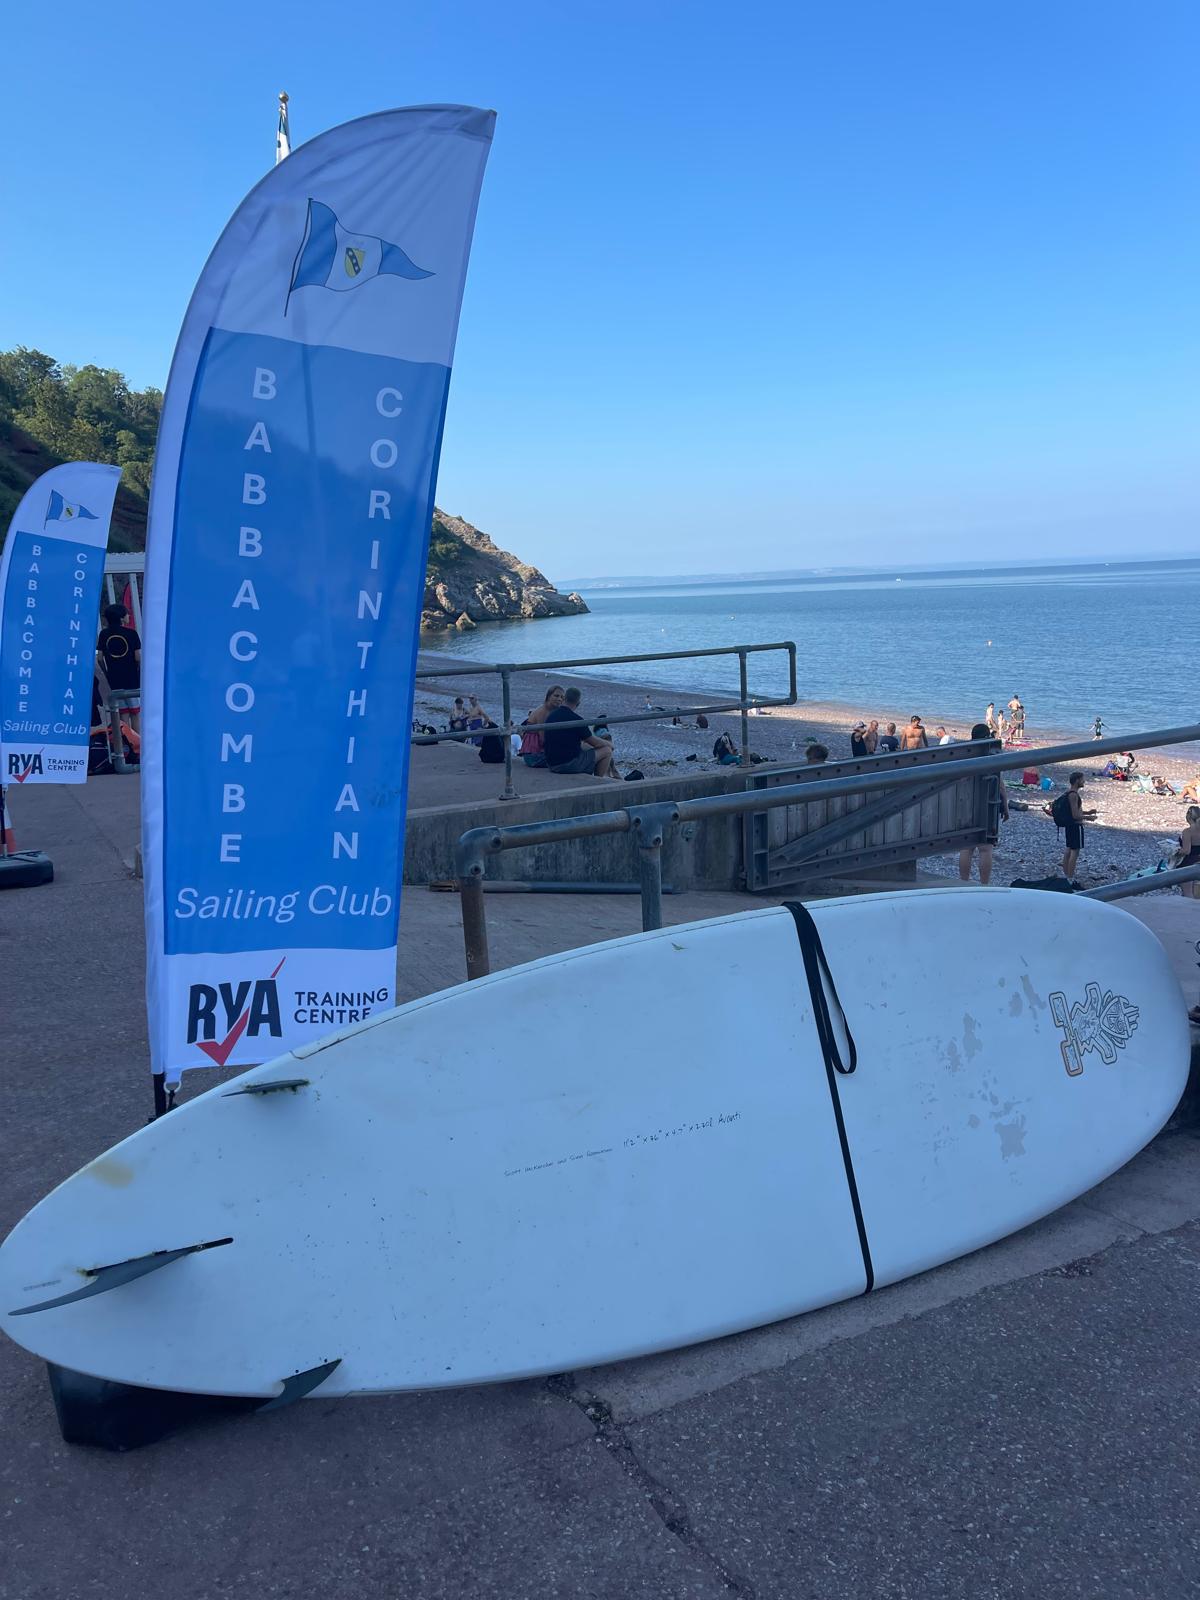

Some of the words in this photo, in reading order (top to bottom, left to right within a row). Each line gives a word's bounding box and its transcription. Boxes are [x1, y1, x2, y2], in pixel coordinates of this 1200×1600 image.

[18, 544, 42, 713] BABBACOMBE
[62, 552, 88, 716] CORINTHIAN
[219, 366, 278, 864] BABBACOMBE
[332, 386, 404, 861] CORINTHIAN
[3, 720, 51, 735] Sailing
[53, 722, 87, 735] Club
[8, 753, 44, 775] RYA
[47, 758, 85, 766] TRAINING
[47, 764, 78, 772] CENTRE
[174, 887, 300, 923] Sailing
[308, 884, 392, 917] Club
[187, 978, 283, 1045] RYA
[294, 987, 389, 1007] TRAINING
